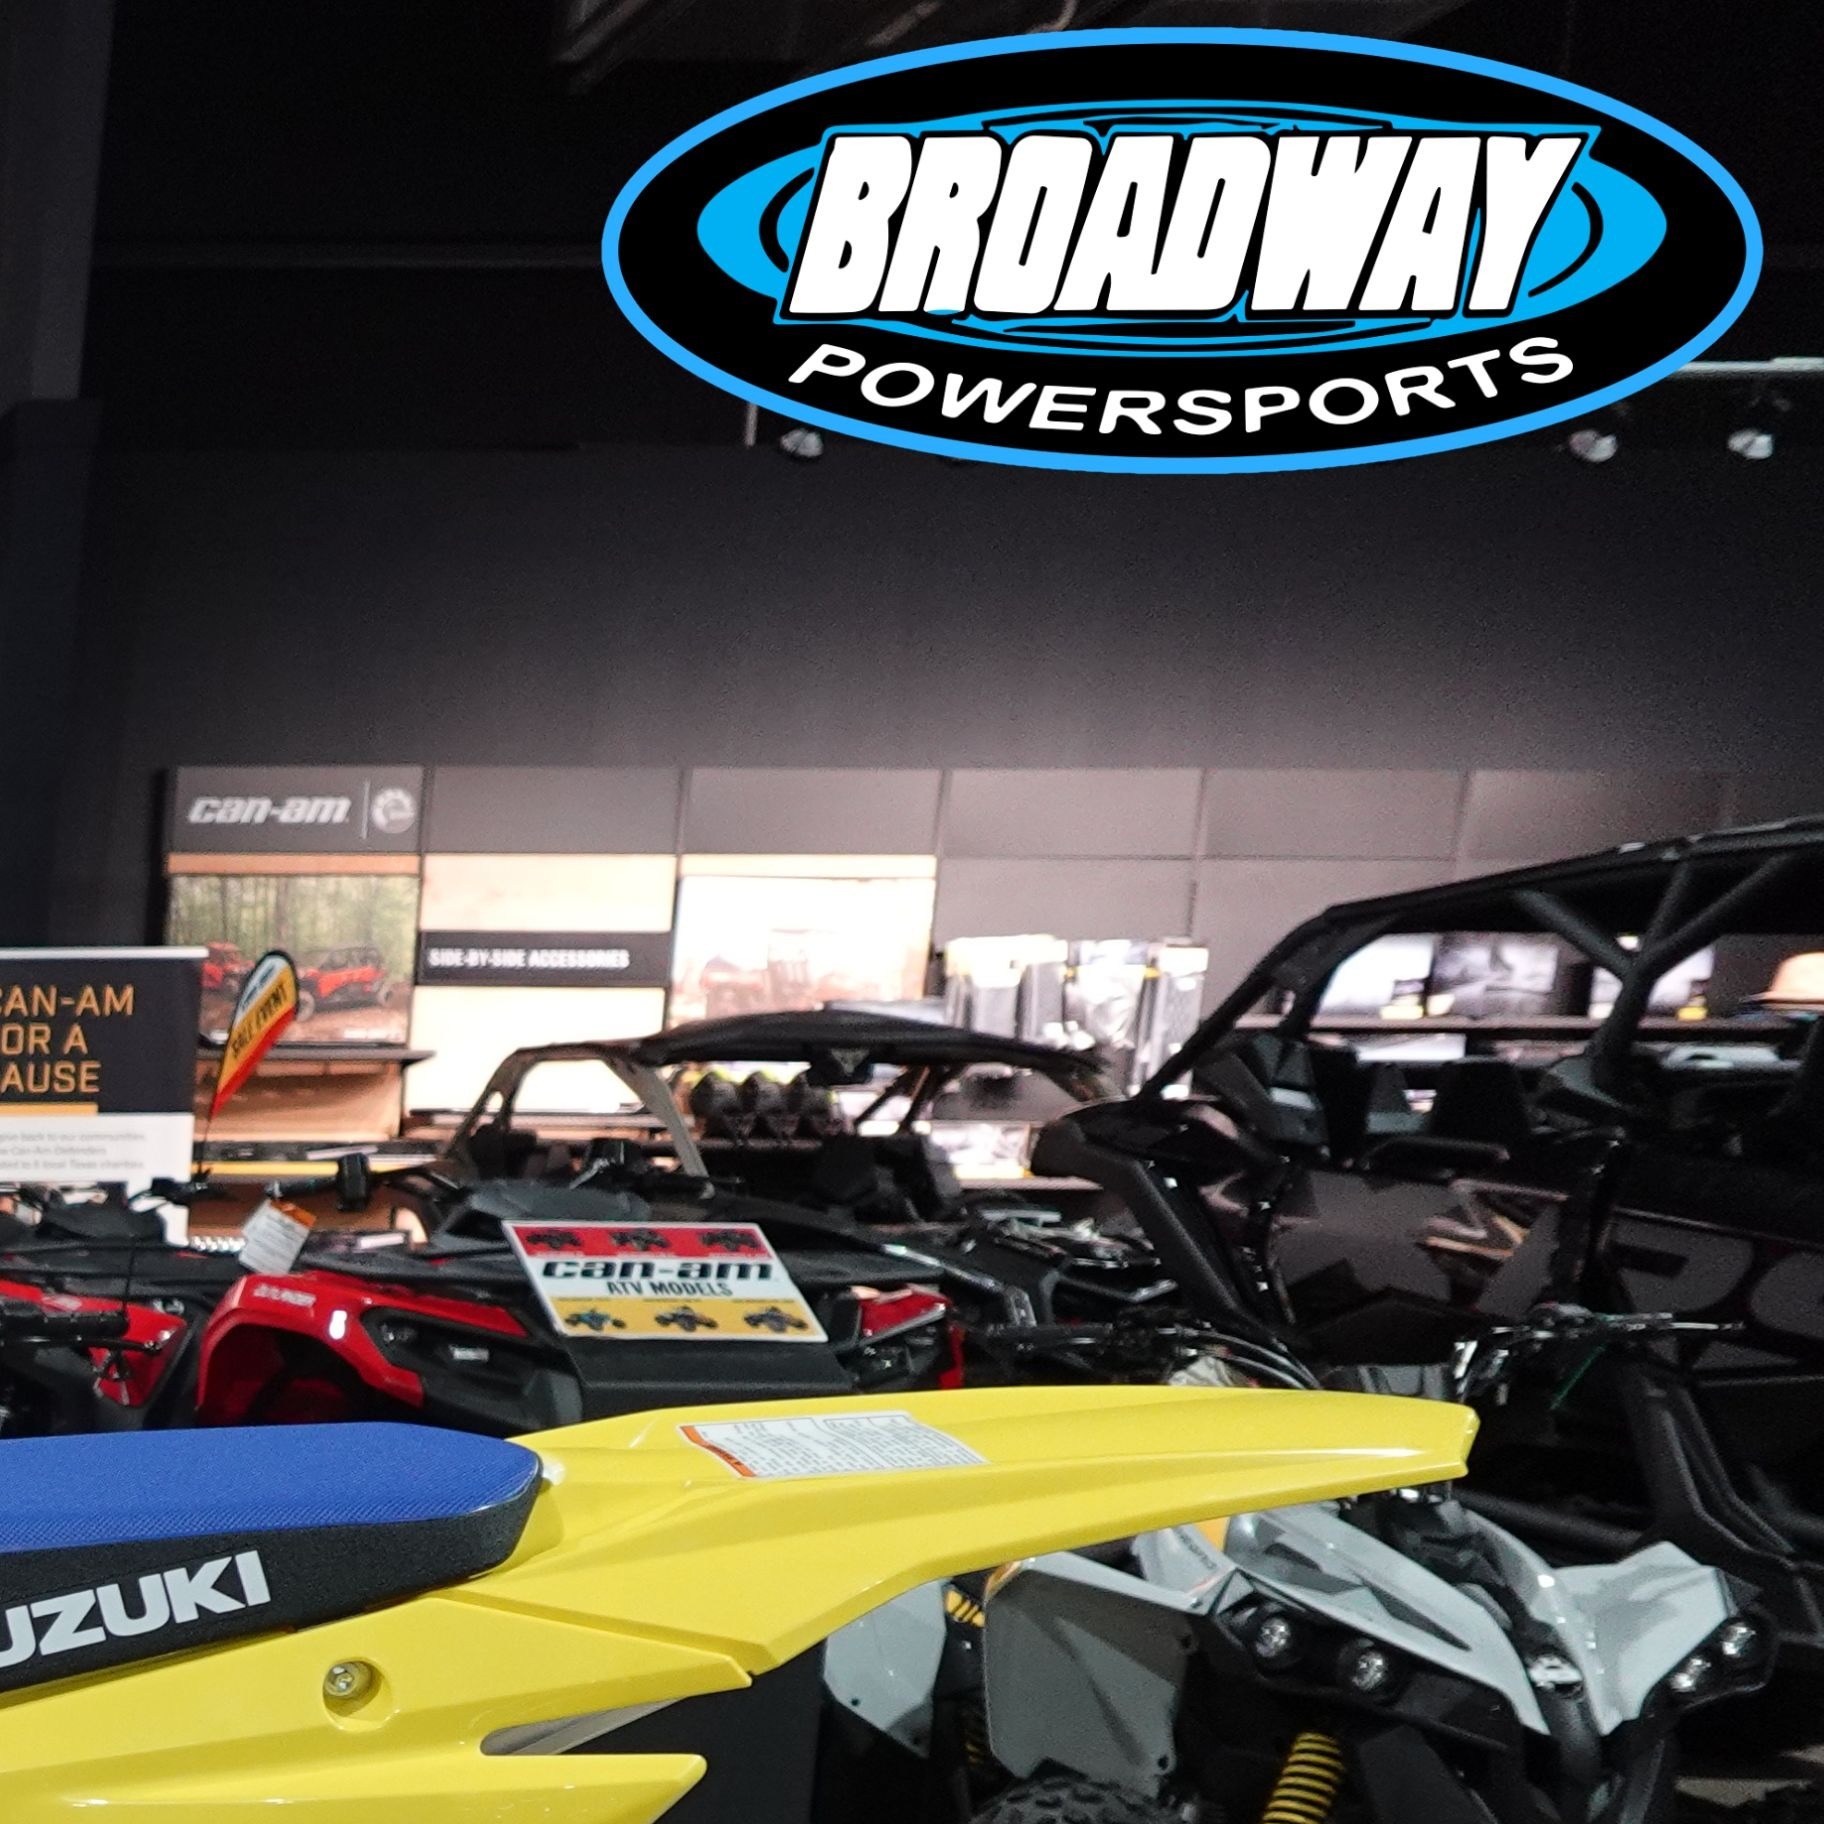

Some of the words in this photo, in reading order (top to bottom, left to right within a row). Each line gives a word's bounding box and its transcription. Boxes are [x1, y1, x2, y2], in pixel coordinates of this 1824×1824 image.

[187, 796, 351, 824] can-am
[528, 948, 631, 970] ACCESSORIES
[63, 1022, 89, 1055] A
[541, 1261, 773, 1280] can-am
[606, 1280, 644, 1296] ATV
[651, 1280, 734, 1298] MODELS
